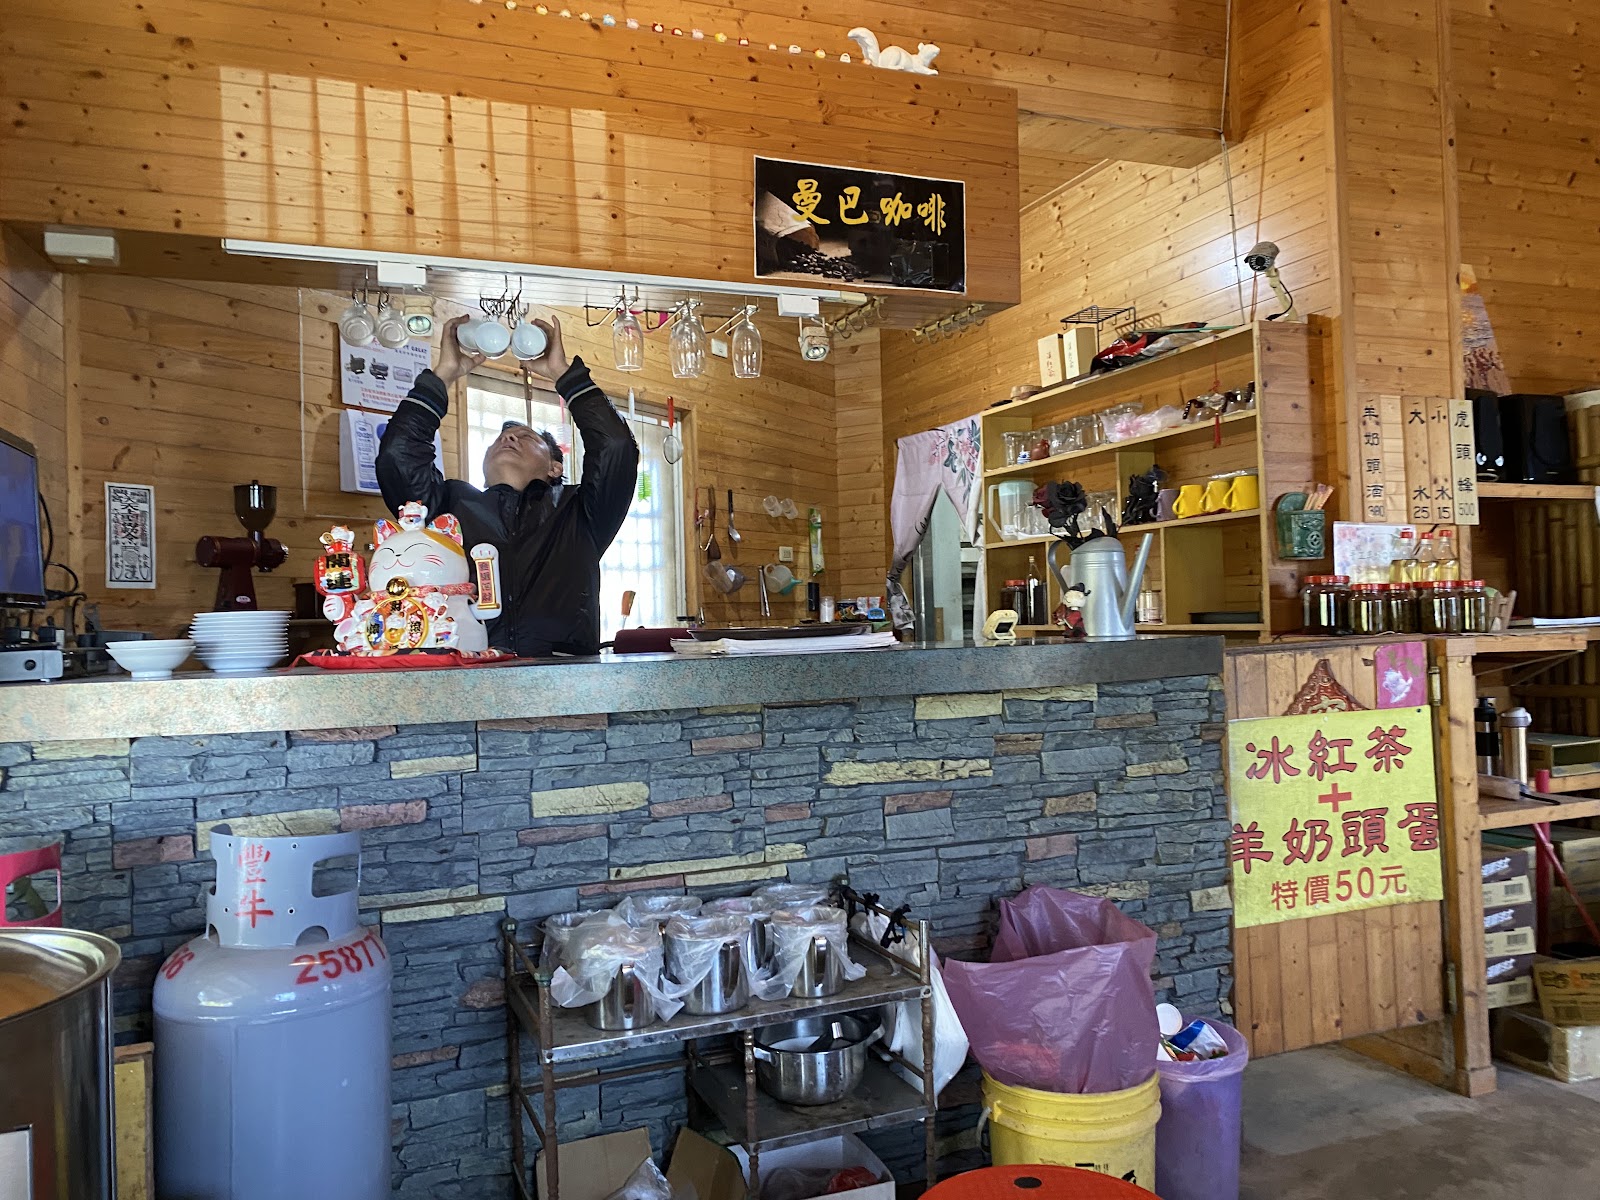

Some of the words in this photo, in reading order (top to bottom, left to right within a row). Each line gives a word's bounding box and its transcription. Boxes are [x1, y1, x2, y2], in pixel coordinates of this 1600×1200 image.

[791, 178, 947, 236] 曼巴咖啡
[1454, 411, 1473, 493] 虎頭蜂
[1413, 505, 1430, 519] 25
[1437, 506, 1451, 519] 15
[1245, 724, 1413, 784] 冰紅茶
[1232, 802, 1438, 874] 羊奶頭蛋
[234, 844, 274, 929] 豐牛
[1270, 865, 1408, 911] 特價50元
